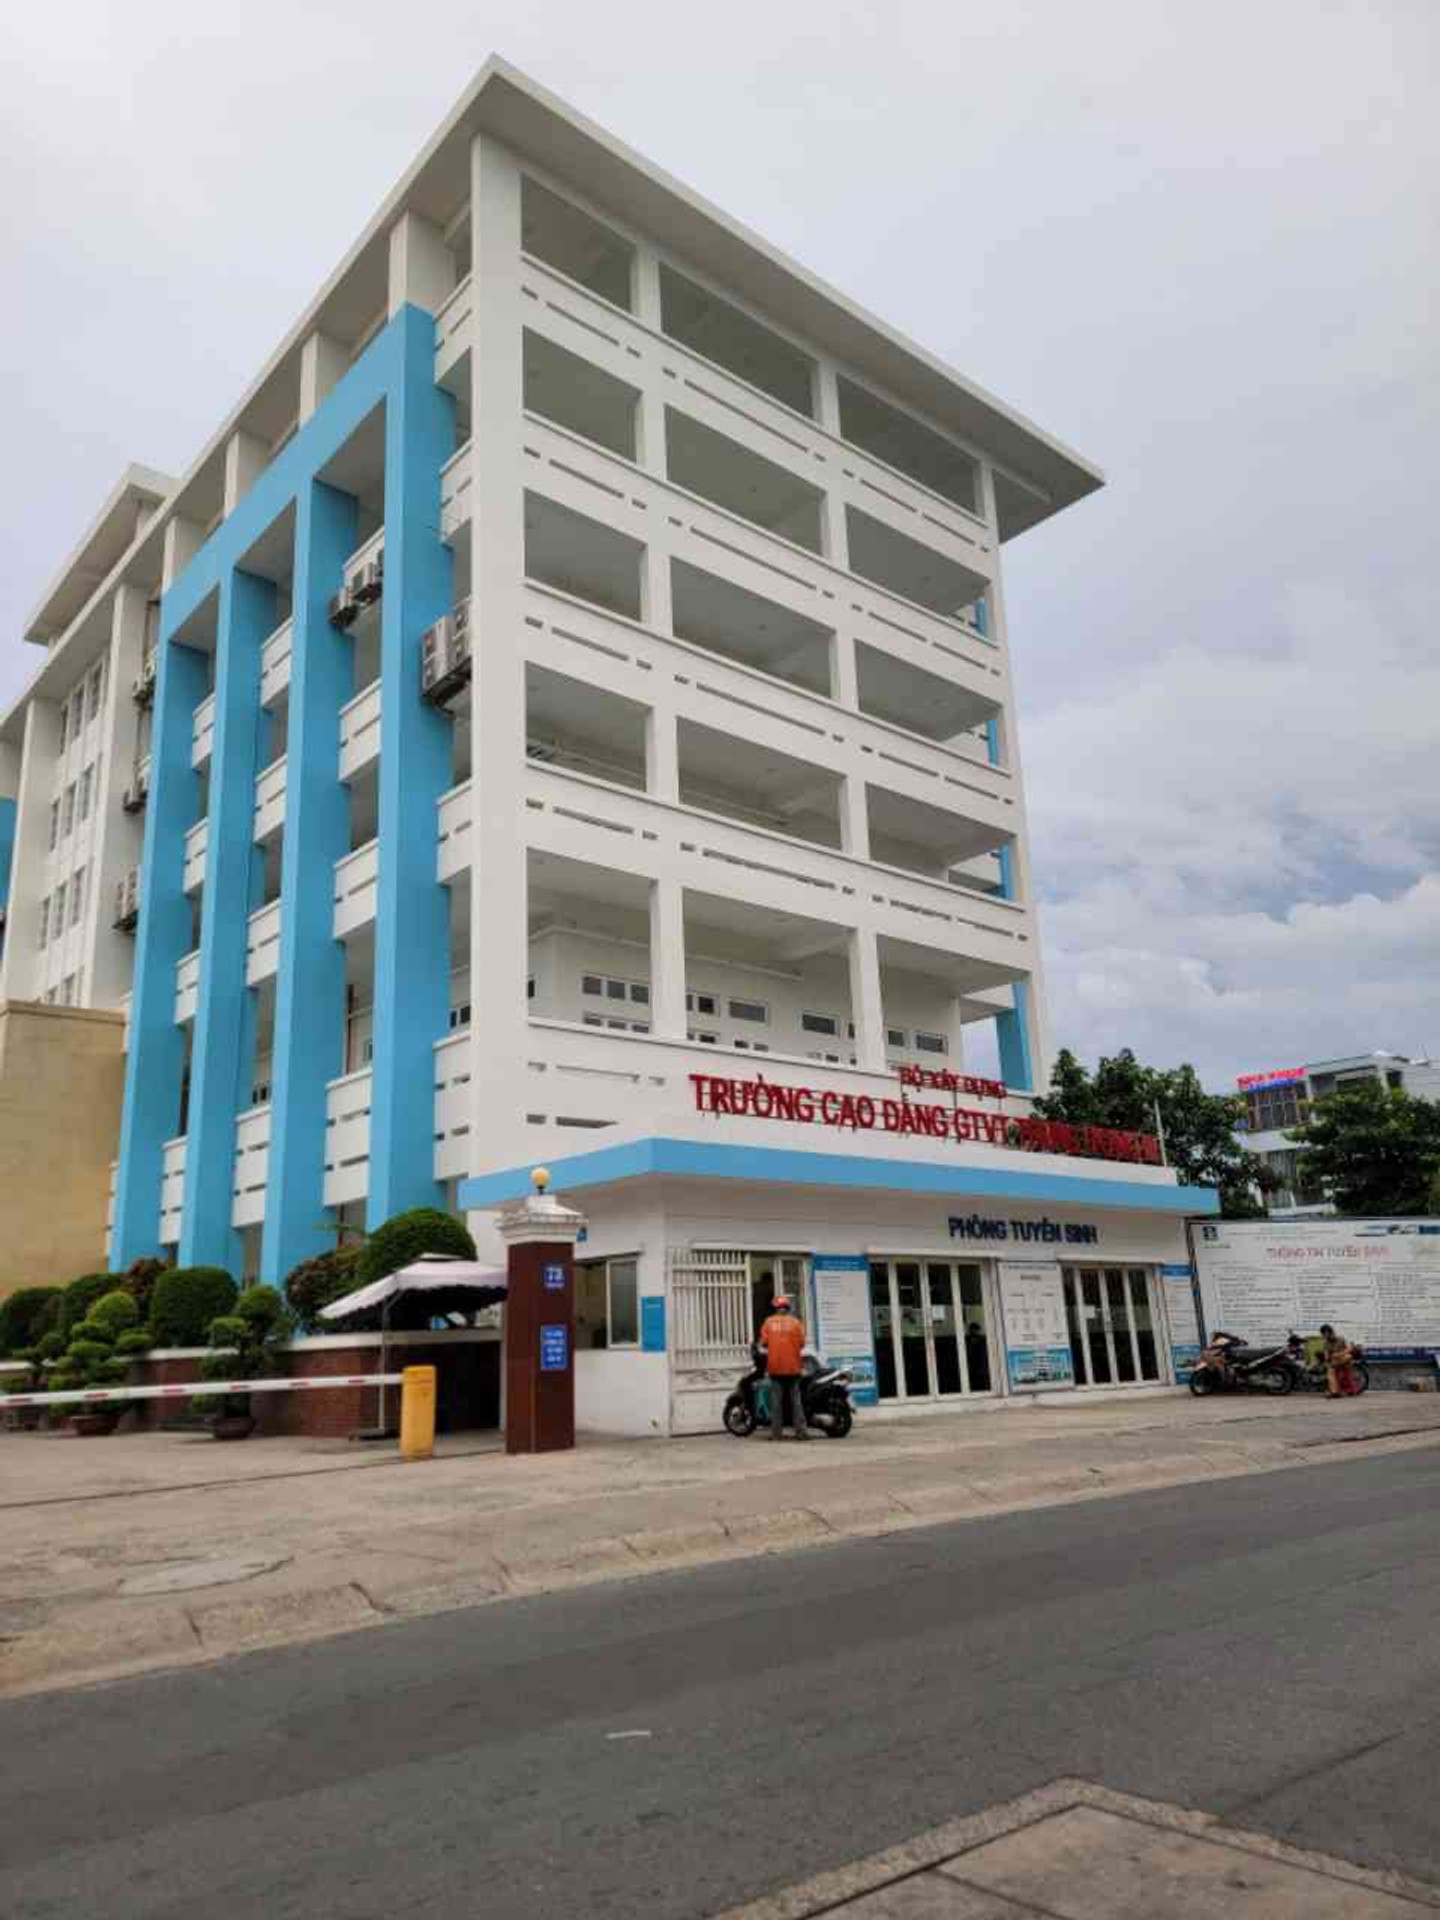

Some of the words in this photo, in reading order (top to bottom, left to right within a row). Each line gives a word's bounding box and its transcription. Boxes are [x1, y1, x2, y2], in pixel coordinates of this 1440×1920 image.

[688, 1073, 814, 1122] TRƯỜNG
[821, 1089, 875, 1129] CAO
[882, 1092, 948, 1137] ĐẲNG
[955, 1109, 1011, 1144] GTVT
[948, 1214, 1007, 1240] PHÒNG
[1009, 1216, 1062, 1243] TUYỂN
[1064, 1224, 1098, 1244] SINH
